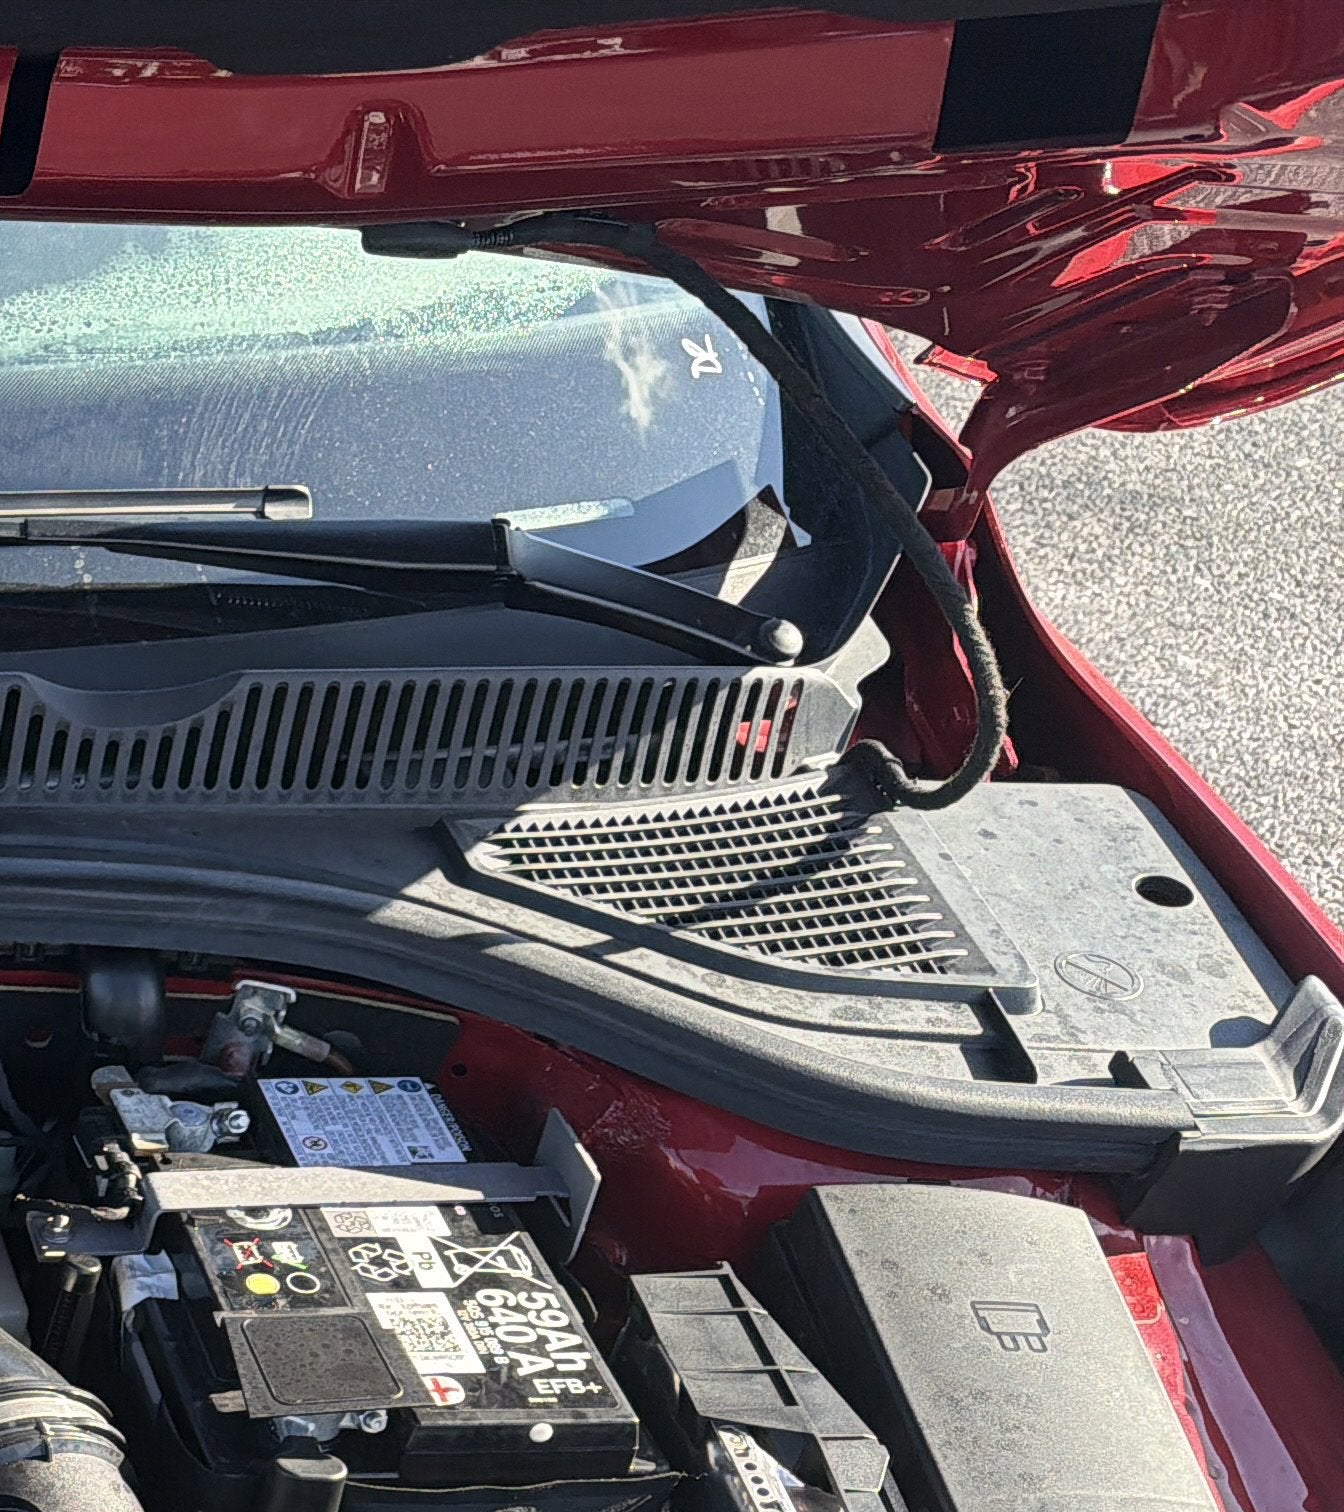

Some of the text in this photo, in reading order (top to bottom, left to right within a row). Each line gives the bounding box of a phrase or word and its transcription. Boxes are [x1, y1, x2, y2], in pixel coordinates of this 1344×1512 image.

[412, 1252, 436, 1270] Pb
[475, 1288, 538, 1344] 640
[507, 1351, 555, 1377] A
[516, 1291, 593, 1372] 59Ah
[532, 1378, 602, 1394] EFB+
